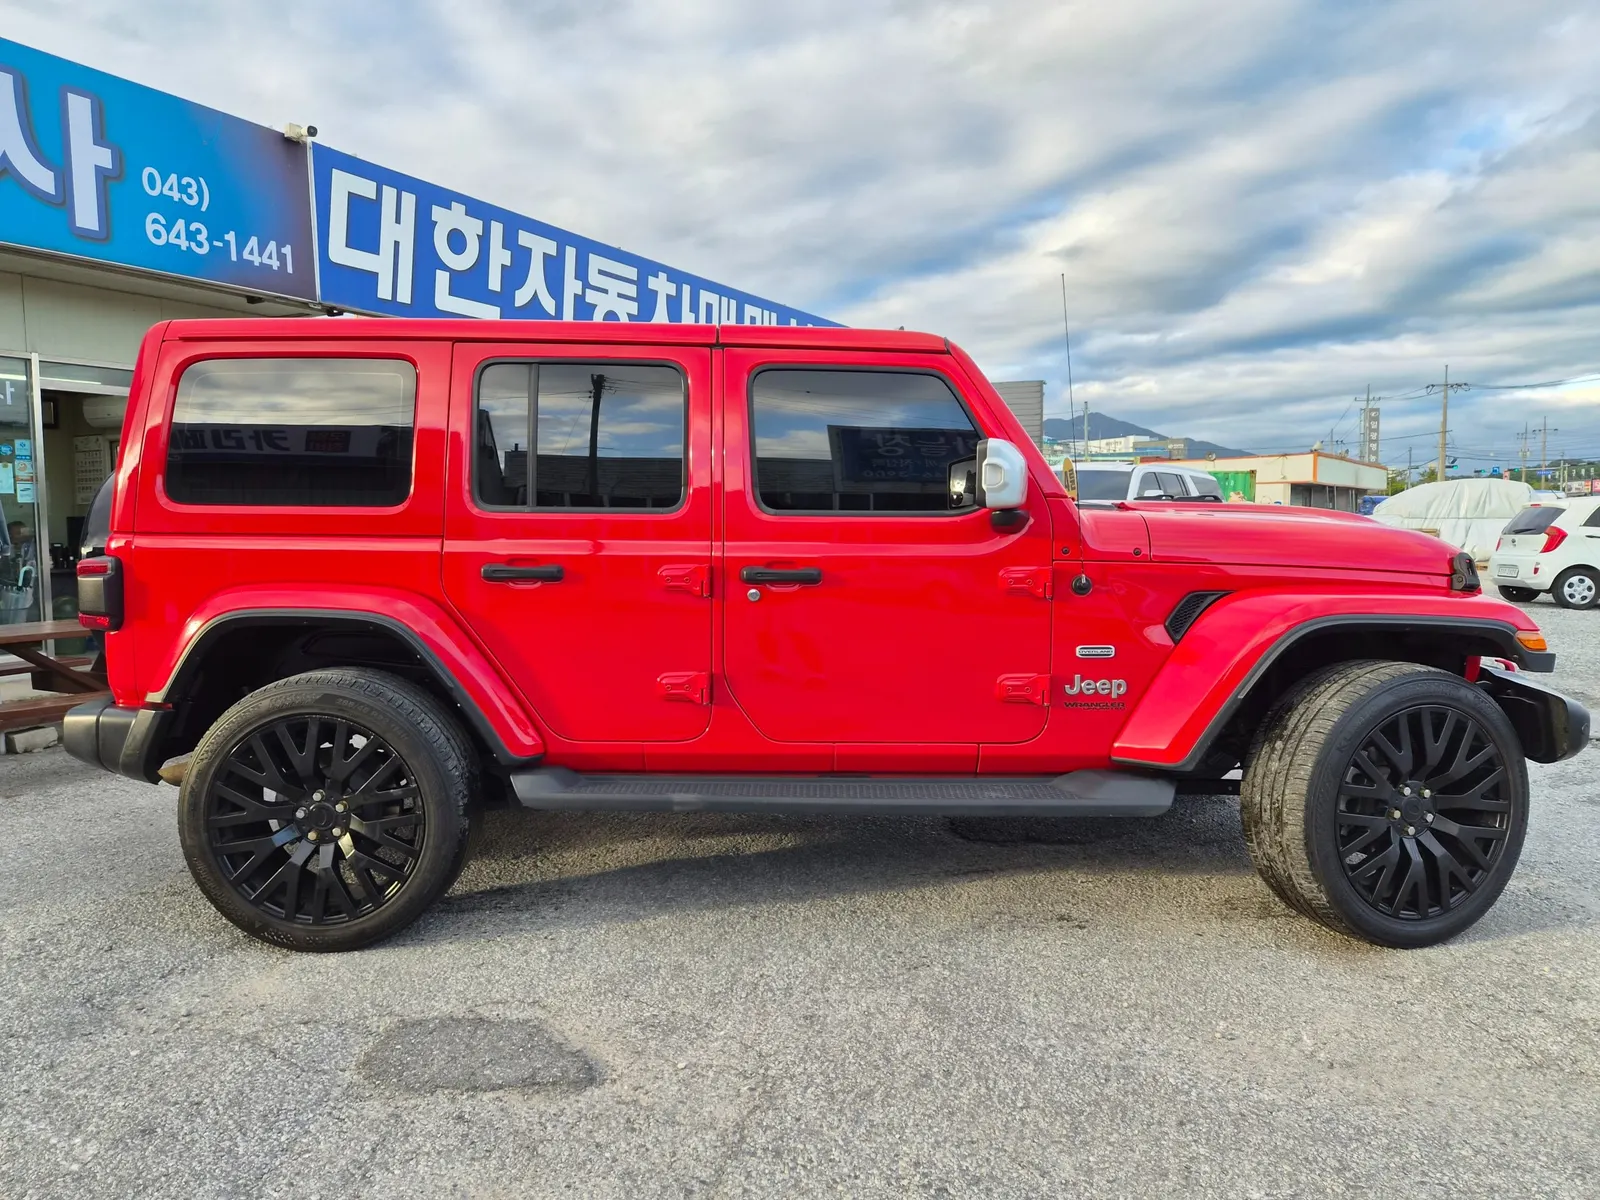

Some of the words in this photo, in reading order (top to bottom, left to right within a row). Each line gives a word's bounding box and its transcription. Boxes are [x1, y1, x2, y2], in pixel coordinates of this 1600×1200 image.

[141, 166, 210, 212] 043)
[145, 212, 294, 274] 643-1441
[1064, 674, 1127, 698] Jeep
